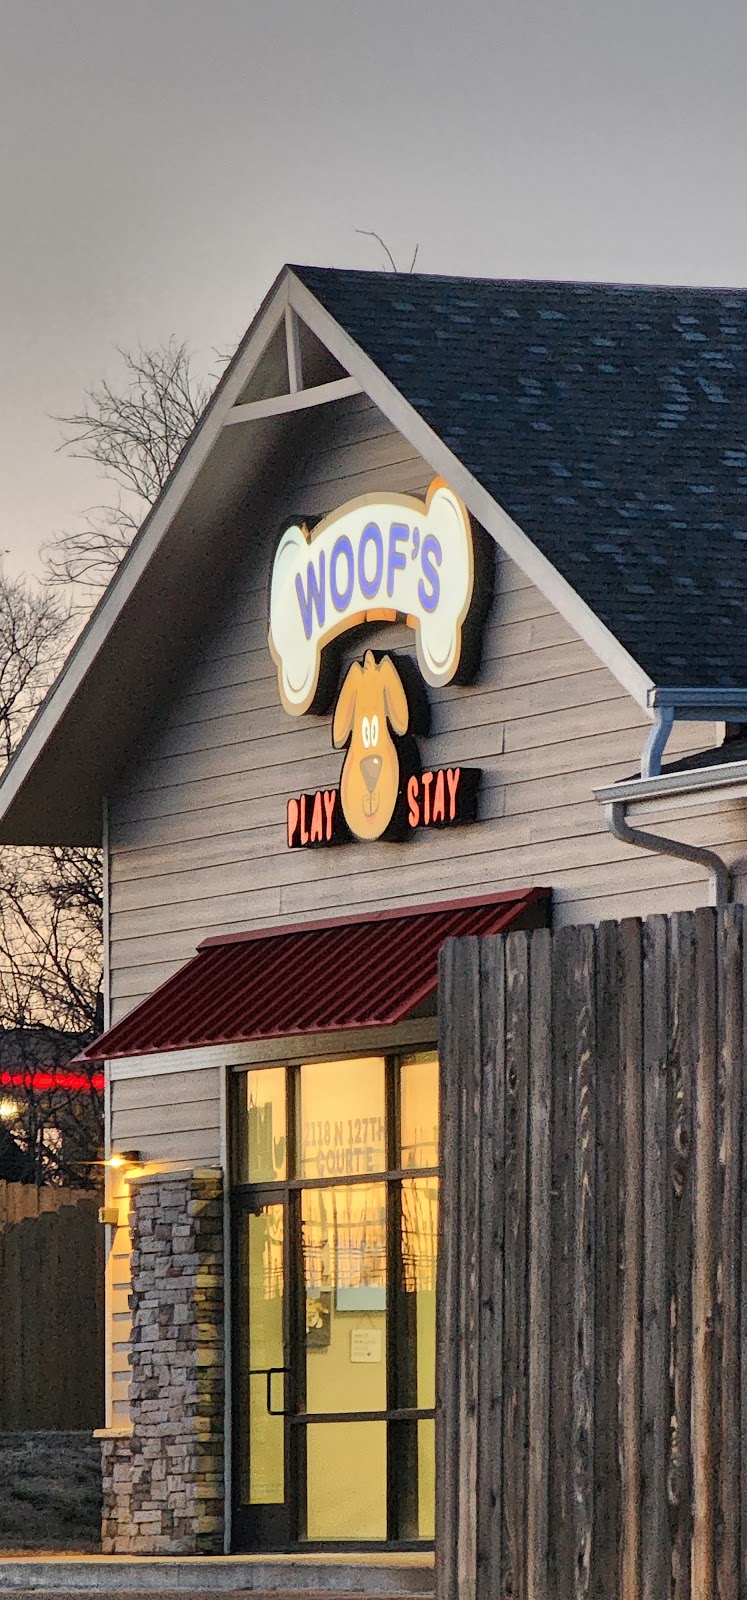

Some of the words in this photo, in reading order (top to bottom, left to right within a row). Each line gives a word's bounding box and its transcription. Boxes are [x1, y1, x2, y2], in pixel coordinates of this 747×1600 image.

[295, 522, 442, 640] WOOF'S
[287, 789, 336, 848] PLAY
[407, 767, 461, 828] STAY
[304, 1120, 331, 1147] 2118
[334, 1121, 344, 1147] N
